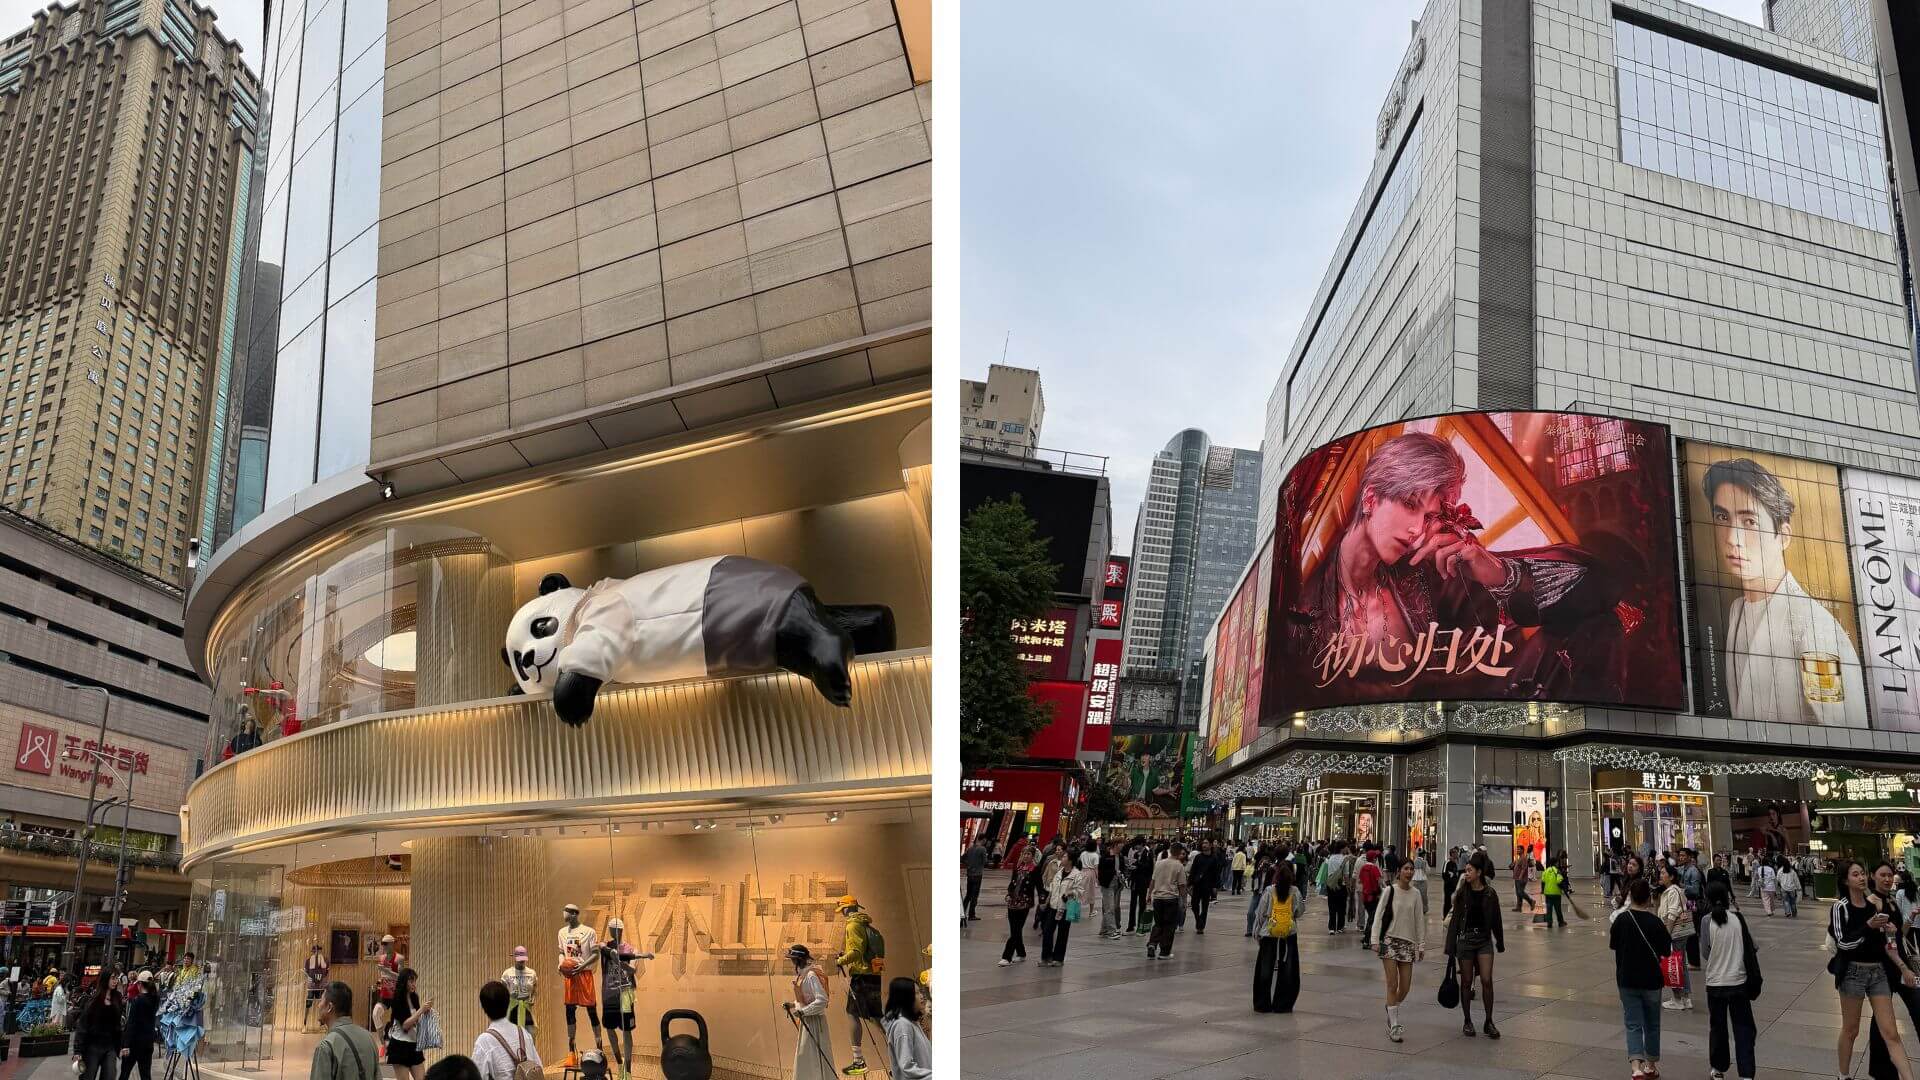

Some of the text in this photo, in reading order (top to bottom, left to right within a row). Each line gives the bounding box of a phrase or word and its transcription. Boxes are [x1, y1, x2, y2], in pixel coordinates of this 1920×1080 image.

[1858, 498, 1908, 696] LANCÔME
[1109, 664, 1118, 682] ANTA
[1312, 621, 1514, 688] 彻心归处
[1086, 663, 1110, 725] 超级安踏
[1642, 773, 1701, 791] 群光广场
[1482, 825, 1510, 833] CHANEL
